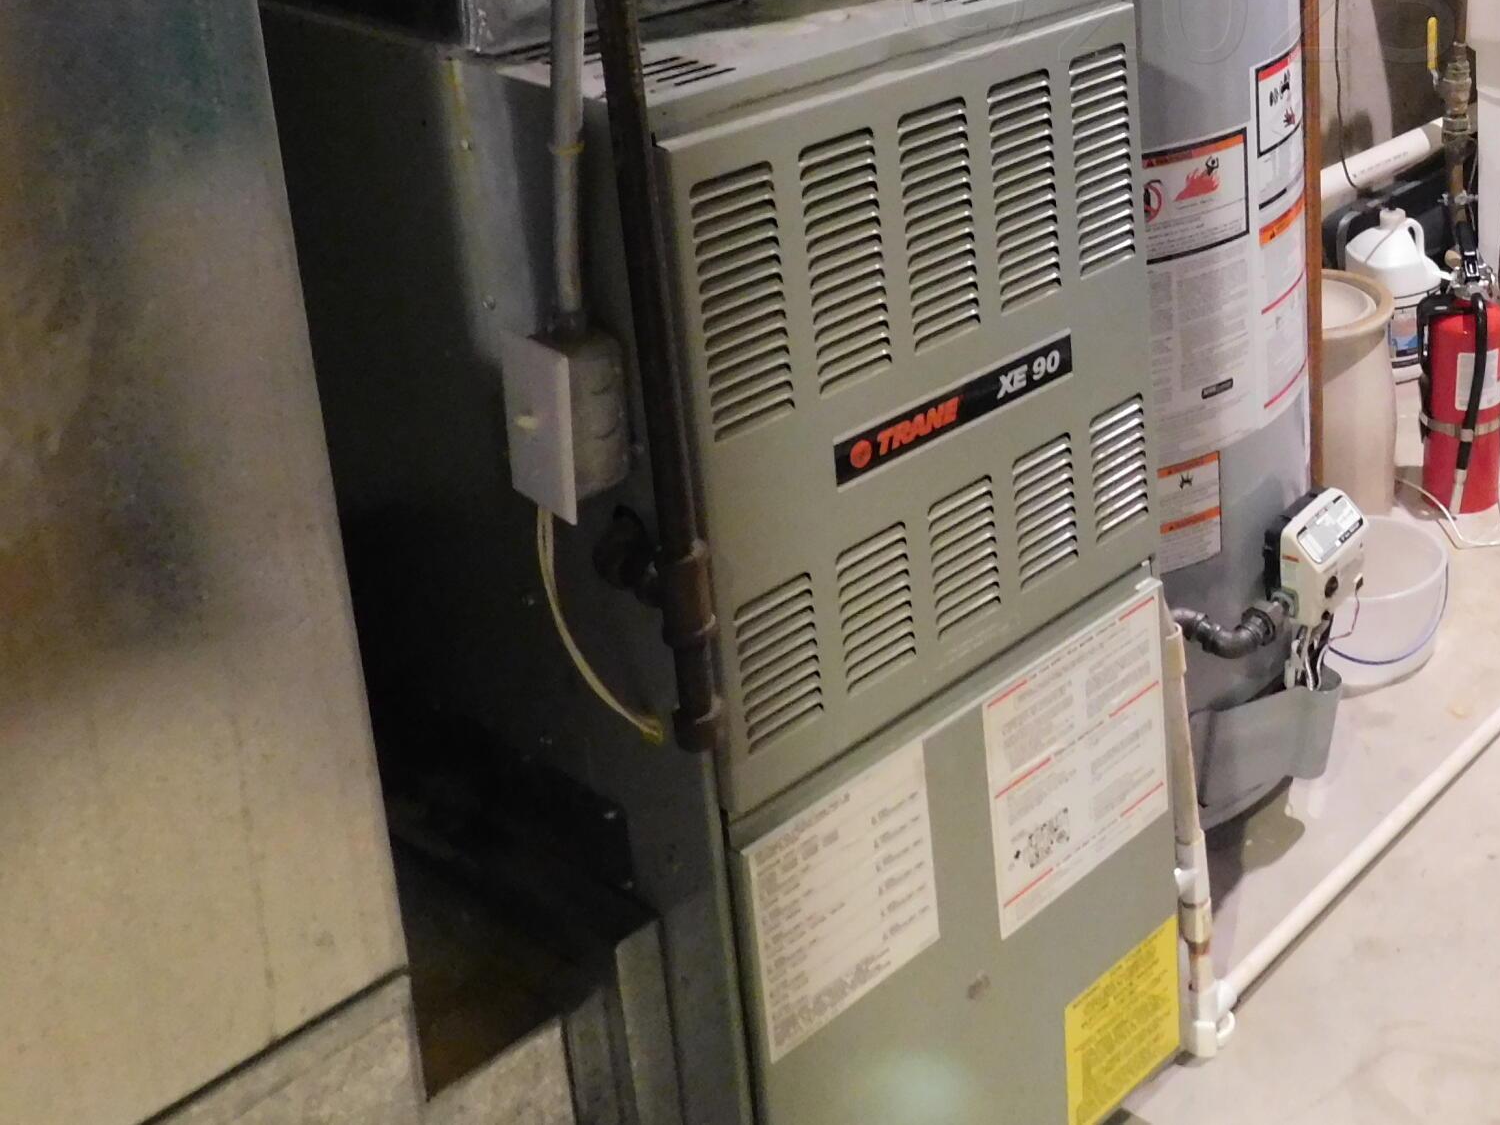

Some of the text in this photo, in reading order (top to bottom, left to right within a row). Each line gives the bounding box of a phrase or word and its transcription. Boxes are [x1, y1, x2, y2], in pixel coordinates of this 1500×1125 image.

[997, 349, 1060, 399] XE 90
[877, 396, 961, 456] TRANE
